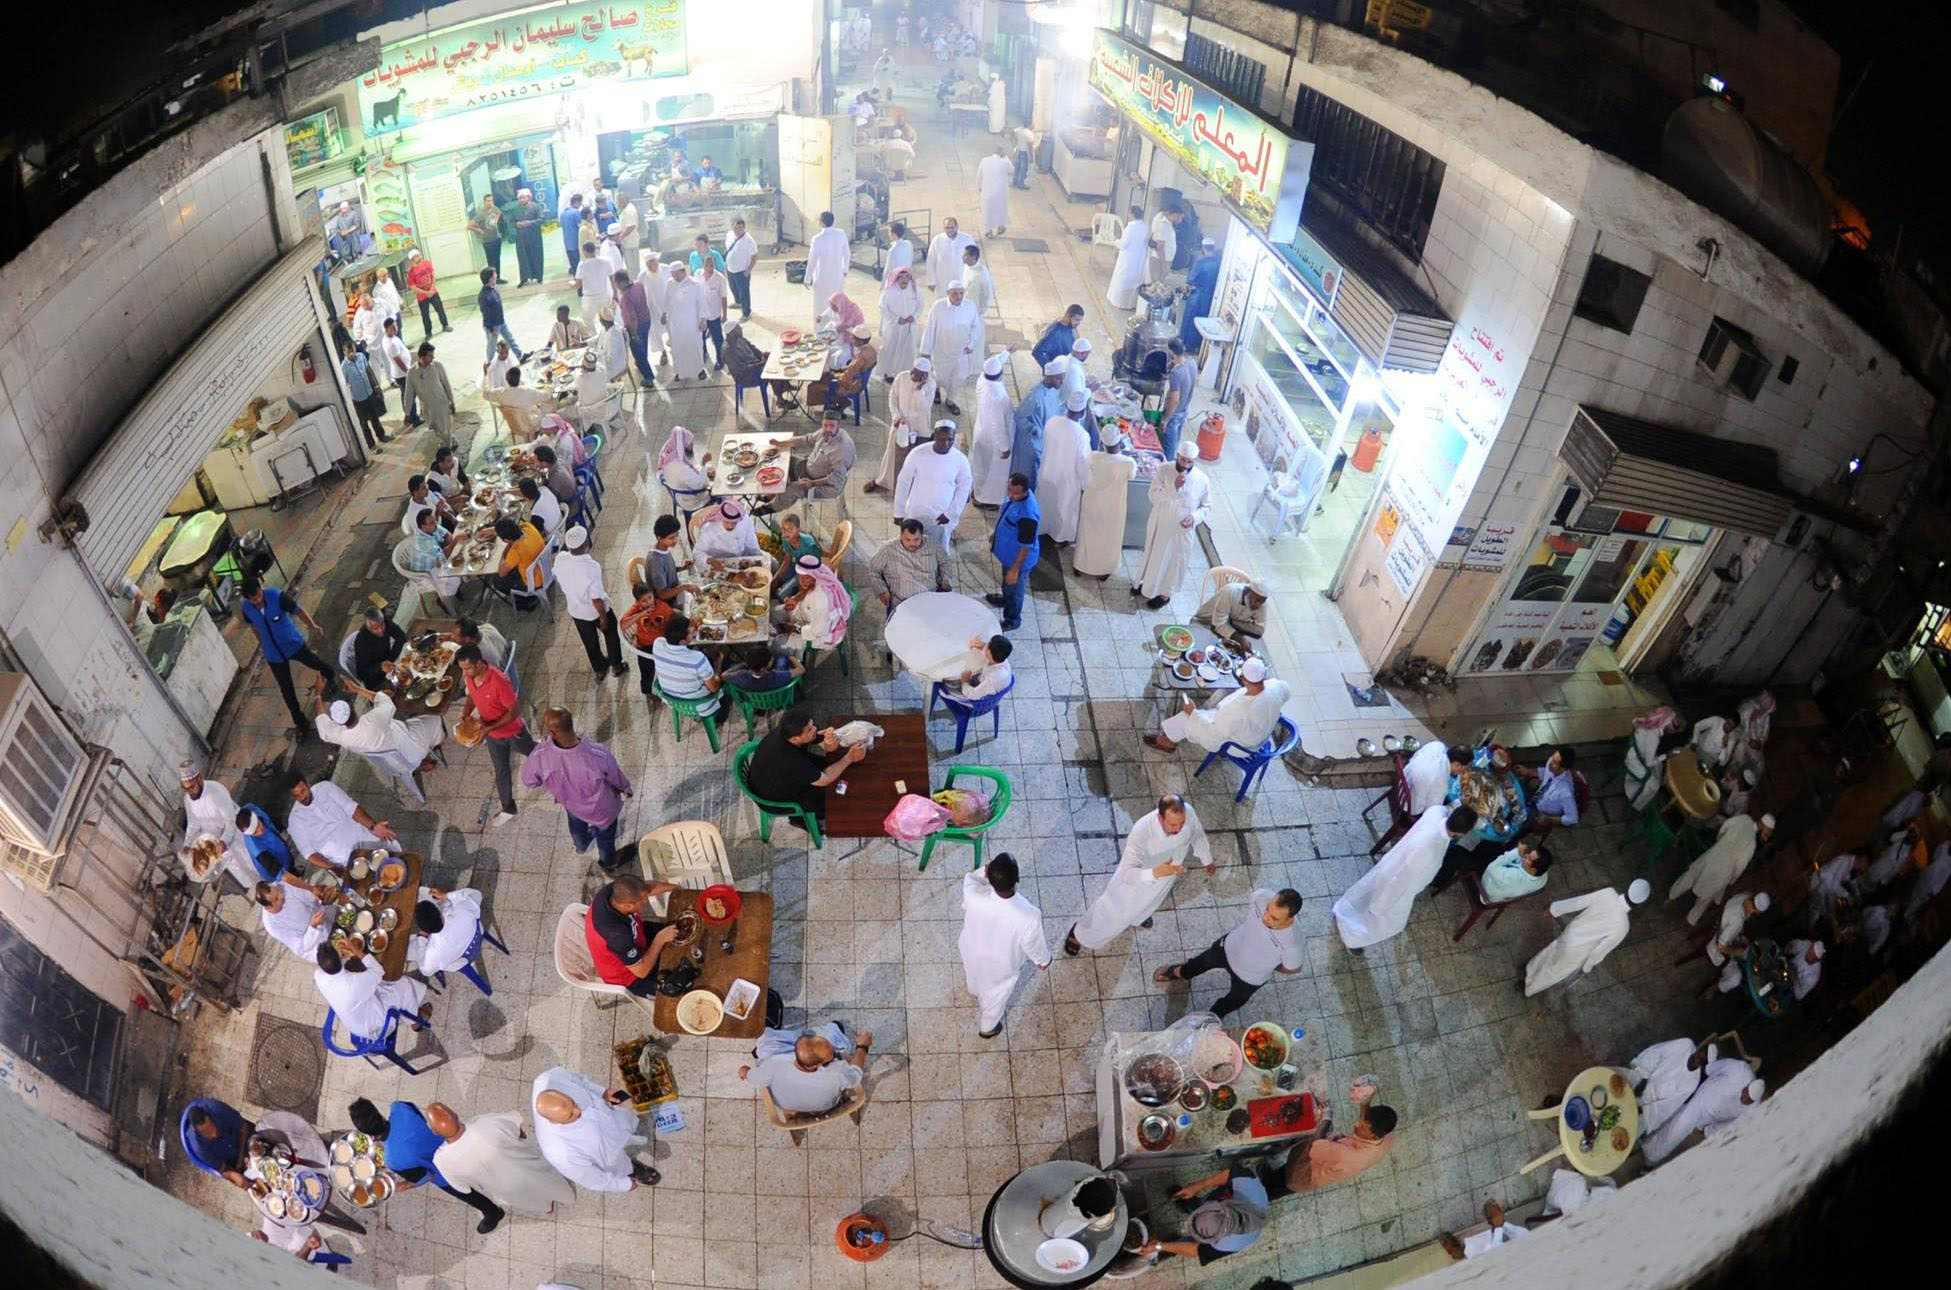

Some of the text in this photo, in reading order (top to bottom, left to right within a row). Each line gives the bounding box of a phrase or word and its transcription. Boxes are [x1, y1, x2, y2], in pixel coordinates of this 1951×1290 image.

[513, 16, 576, 53] سليمان
[581, 6, 638, 41] صالح
[363, 45, 439, 88] للمشويات
[1192, 105, 1272, 193] المعلم
